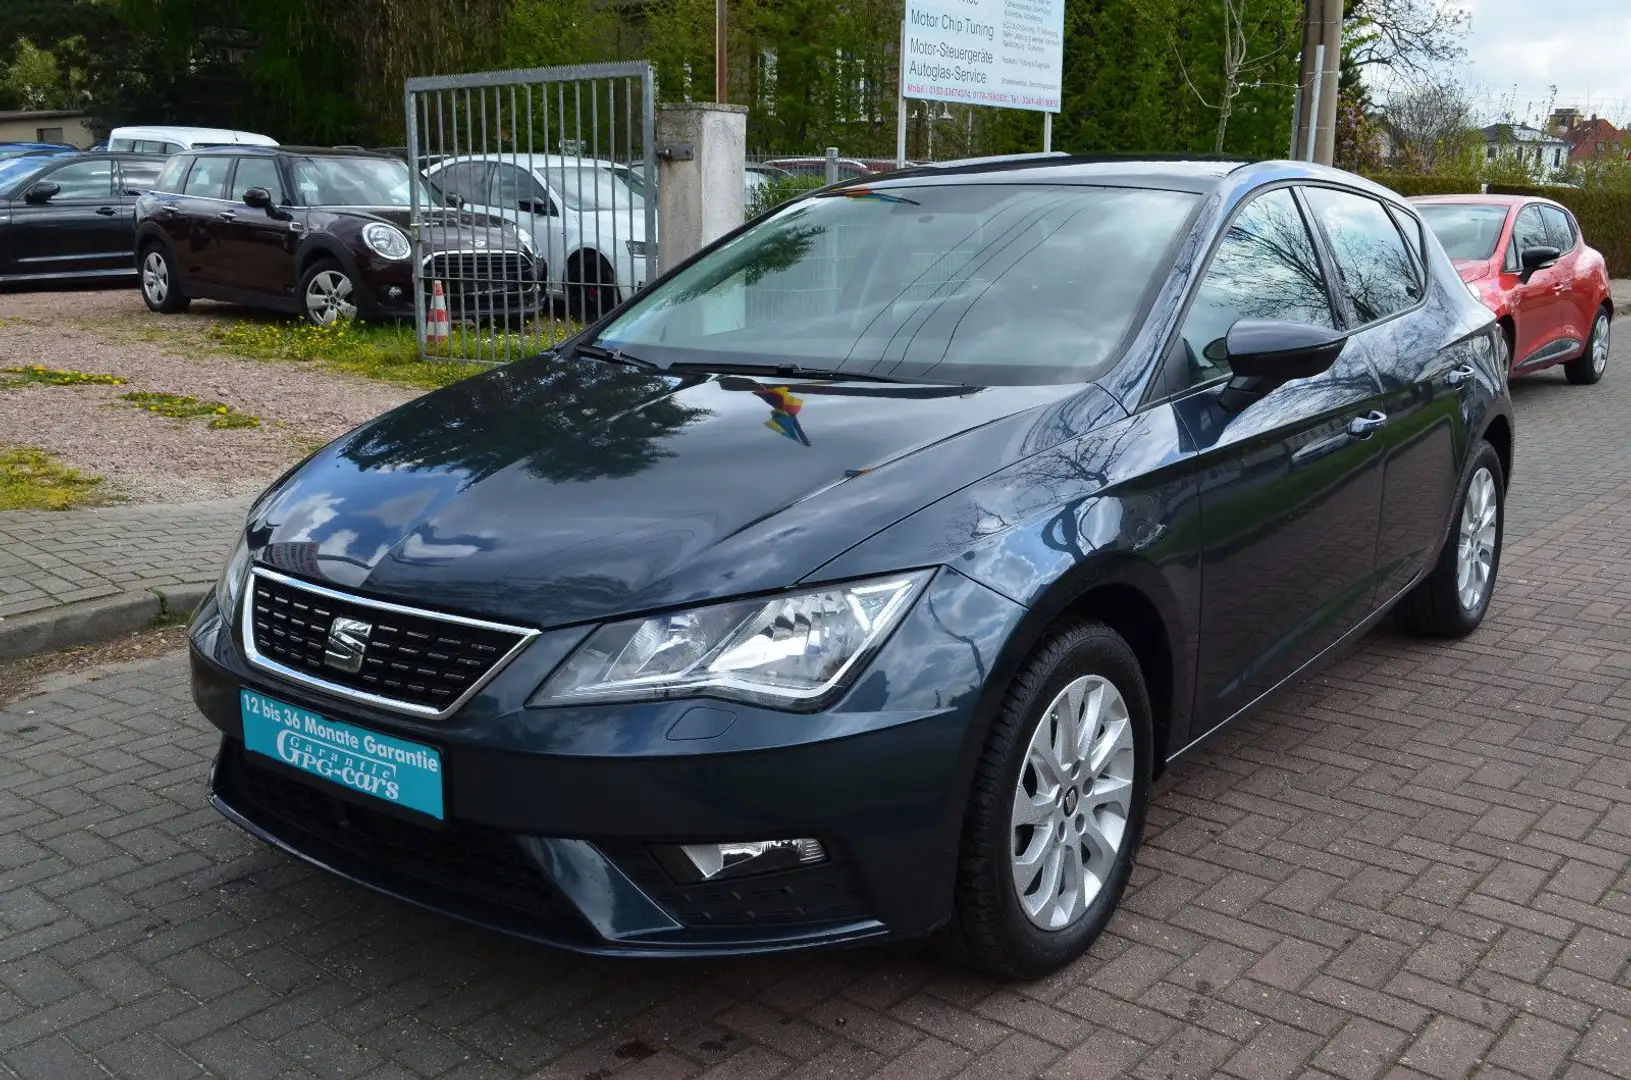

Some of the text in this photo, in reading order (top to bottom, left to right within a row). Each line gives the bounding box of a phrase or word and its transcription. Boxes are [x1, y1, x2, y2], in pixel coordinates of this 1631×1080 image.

[911, 9, 939, 27] Motor
[941, 14, 963, 36] Chip
[965, 18, 994, 41] Tuning
[910, 37, 993, 65] Motor-Steuergeräte
[909, 59, 987, 84] Autoglas-Service
[243, 694, 439, 772] 12 bis 36 Monate Garantie
[276, 729, 400, 800] GPG-cars
[289, 735, 391, 779] Garantie
